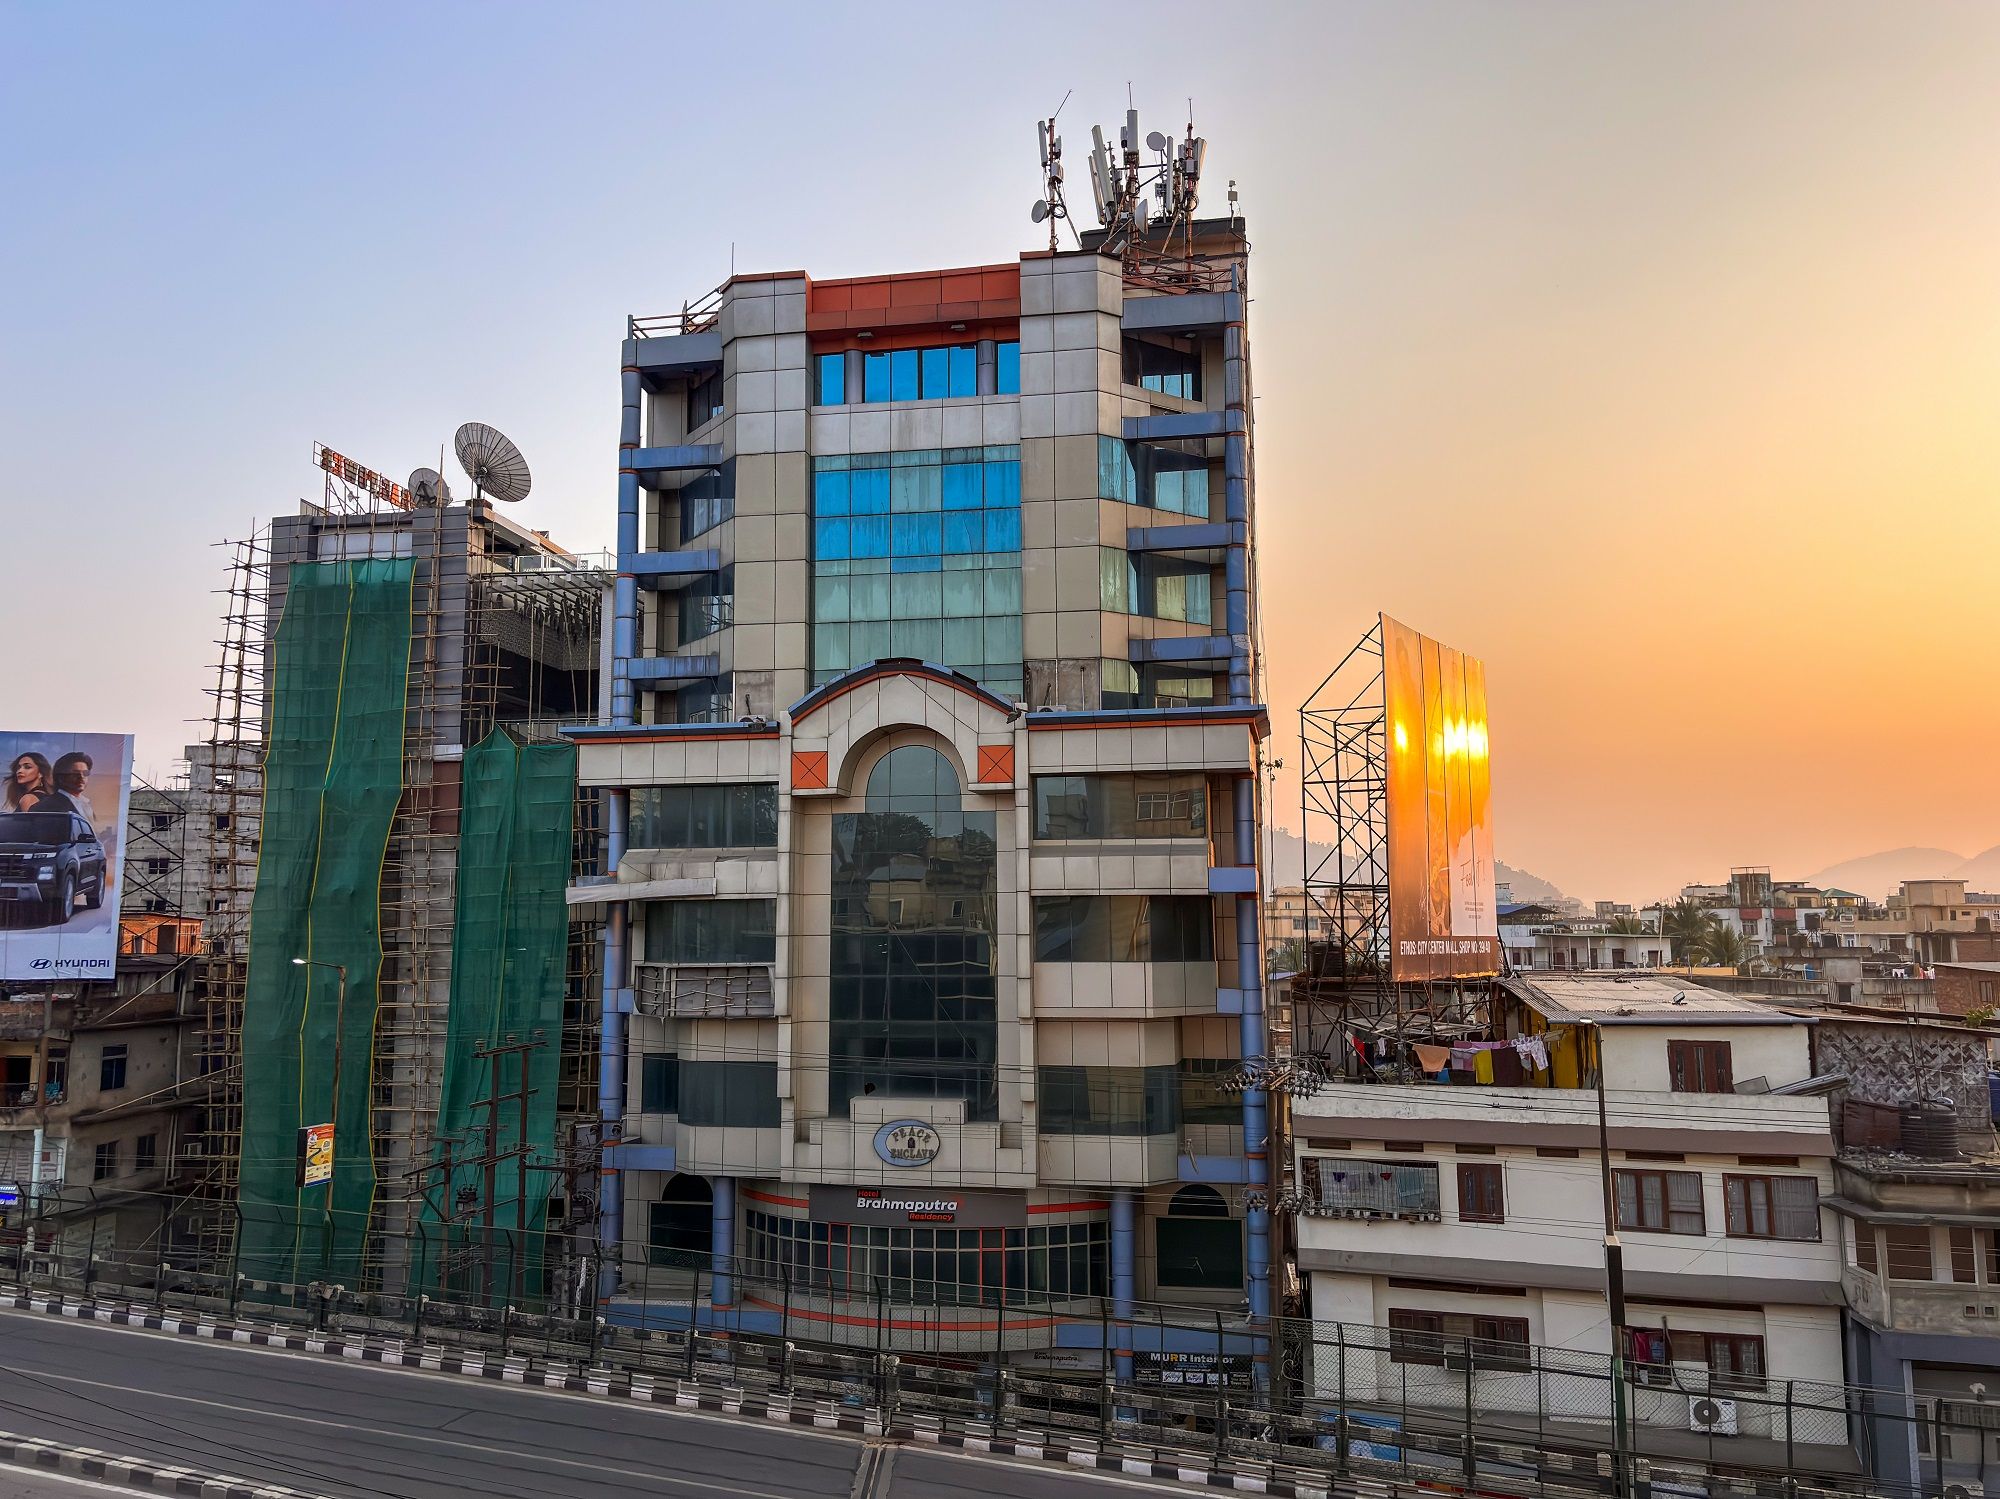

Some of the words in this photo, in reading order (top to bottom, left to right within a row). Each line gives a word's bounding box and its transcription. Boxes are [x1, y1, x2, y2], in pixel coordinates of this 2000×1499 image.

[1400, 941, 1416, 955] ETHOS:
[1417, 941, 1427, 955] CITY
[1428, 941, 1445, 954] CENTER
[1459, 941, 1470, 954] SHOP
[55, 959, 110, 968] HYUNDAI
[891, 1126, 932, 1143] PEACE
[890, 1148, 935, 1159] ENCLAVE
[858, 1190, 879, 1198] Hotel
[856, 1197, 958, 1212] Brahmaputra
[909, 1213, 953, 1221] Residency
[1150, 1352, 1187, 1362] MURR
[1189, 1354, 1235, 1364] Interor
